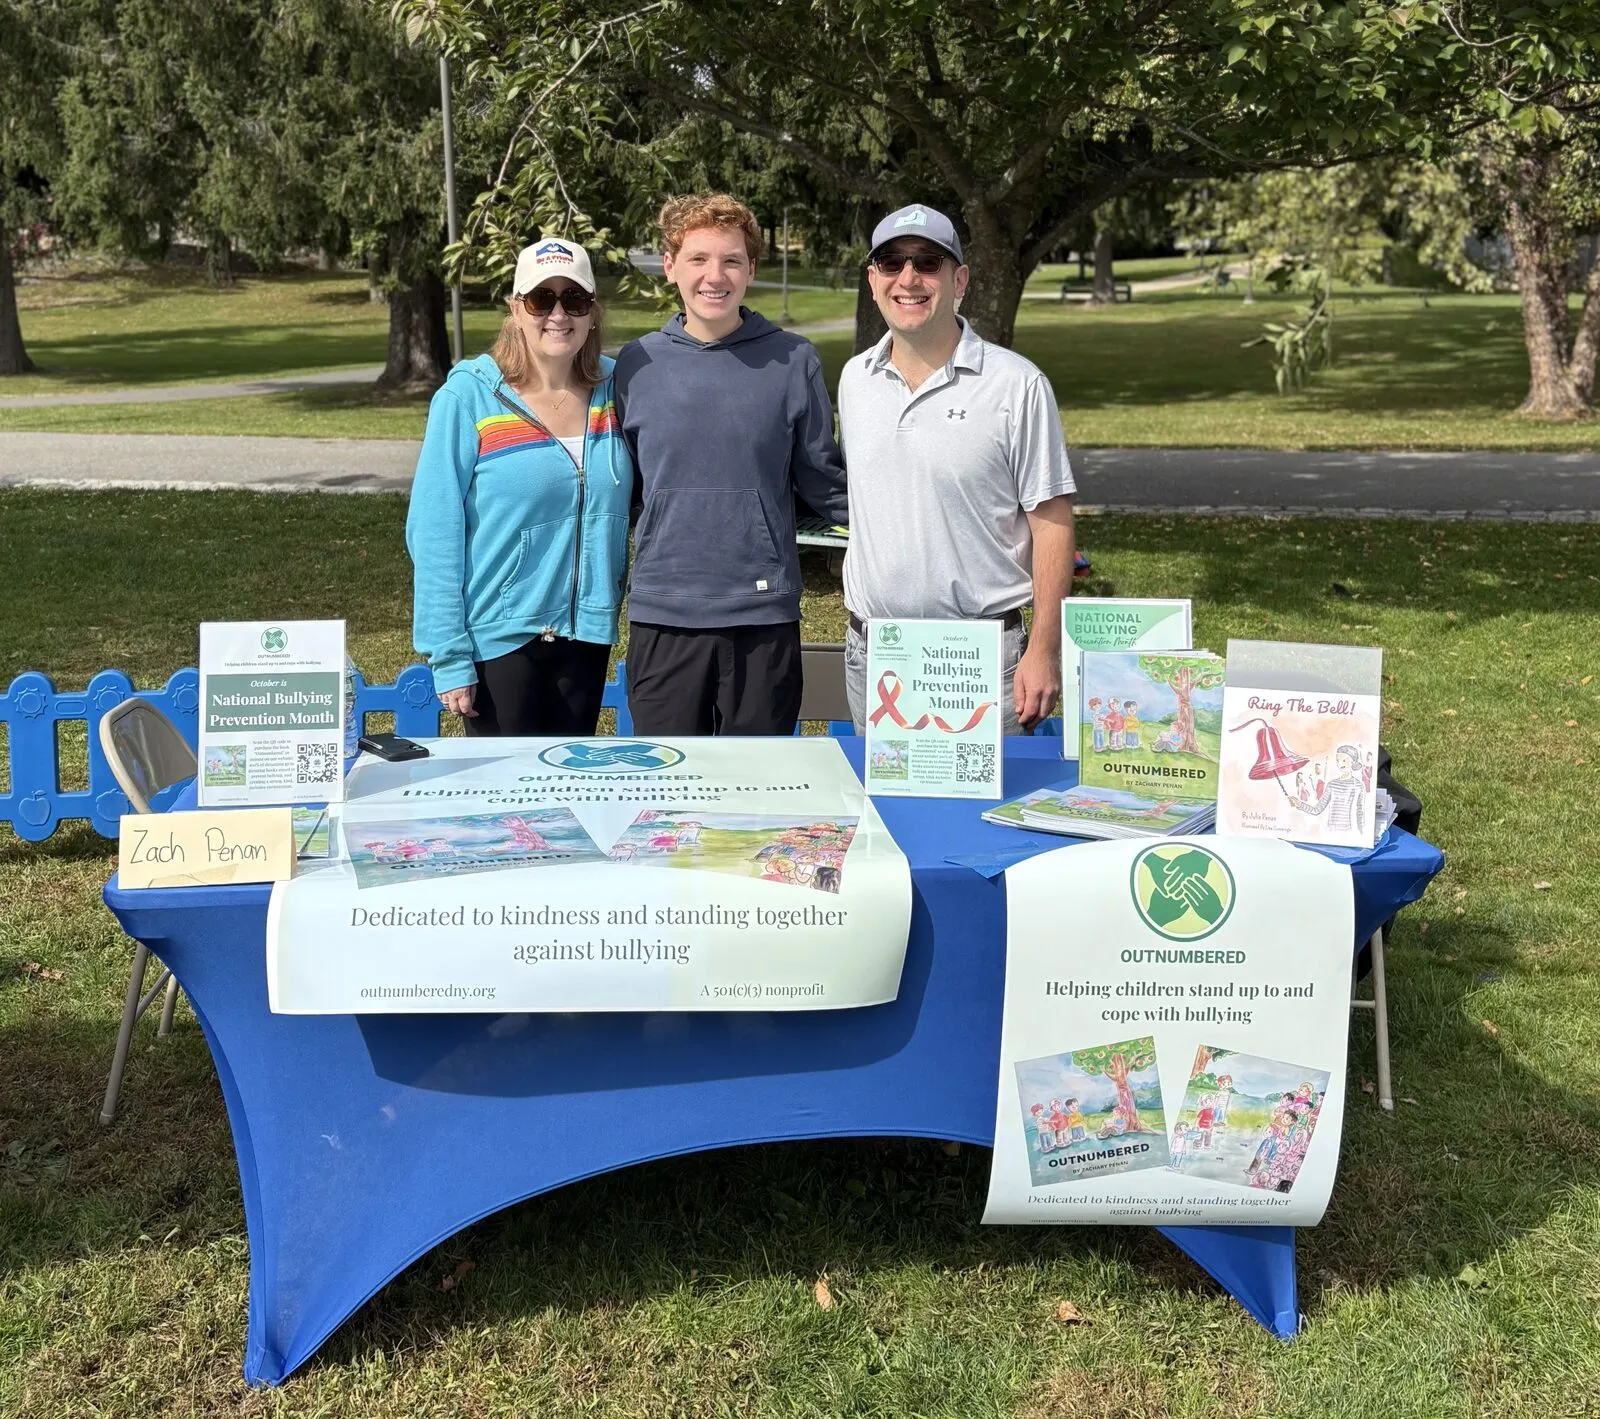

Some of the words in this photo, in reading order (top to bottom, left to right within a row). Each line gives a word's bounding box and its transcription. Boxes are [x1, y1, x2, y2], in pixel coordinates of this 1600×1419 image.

[1074, 612, 1142, 623] NATIONAL
[1074, 624, 1138, 635] BULLYING
[1074, 636, 1112, 648] Prevention
[921, 646, 980, 660] National
[923, 663, 982, 679] Bullying
[250, 679, 280, 688] October
[280, 679, 287, 687] is
[912, 679, 989, 694] Prevention
[212, 692, 271, 706] National
[274, 691, 333, 706] Bullying
[929, 696, 975, 710] Month
[1247, 696, 1283, 717] Ring
[1287, 698, 1313, 714] The
[1317, 700, 1356, 716] Bell!
[210, 713, 285, 726] Prevention
[289, 711, 334, 724] Month
[518, 774, 703, 782] OUTNUMBERED
[1103, 762, 1206, 779] OUTNUMBERED
[403, 788, 504, 797] Helping
[510, 785, 614, 793] children
[622, 784, 689, 792] stand
[765, 783, 811, 791] and
[487, 796, 547, 804] cope
[617, 793, 722, 802] bullying
[130, 829, 185, 864] Zach
[205, 827, 267, 862] Penan
[390, 853, 571, 870] OUTNUMBERED
[350, 905, 465, 927] Dedicated
[472, 907, 494, 926] to
[500, 905, 600, 926] kindness
[607, 904, 648, 925] and
[655, 904, 750, 930] standing
[756, 905, 848, 930] together
[513, 939, 595, 965] against
[600, 938, 691, 965] bullying
[1120, 949, 1246, 964] OUTNUMBERED
[360, 984, 497, 1000] outnumberedny.org
[700, 984, 710, 996] A
[713, 983, 762, 998] 501(c)(3)
[765, 983, 825, 998] nonprofit
[1045, 980, 1112, 999] Helping
[1115, 981, 1185, 998] children
[1189, 982, 1234, 998] stand
[1238, 985, 1260, 1000] up
[1264, 984, 1280, 998] to
[1283, 982, 1314, 998] and
[1101, 1009, 1140, 1024] cope
[1144, 1006, 1180, 1022] with
[1185, 1007, 1253, 1025] bullying
[1048, 1143, 1150, 1168] OUTNUMBERED
[1082, 1164, 1108, 1173] ZACHARY
[1108, 1160, 1129, 1168] PENAN
[1027, 1195, 1088, 1204] Dedicated
[1091, 1196, 1103, 1204] to
[1105, 1195, 1158, 1205] kindness
[1161, 1196, 1183, 1205] and
[1186, 1196, 1239, 1206] standing
[1240, 1197, 1292, 1206] together
[1109, 1208, 1151, 1216] against
[1154, 1208, 1203, 1216] bullying
